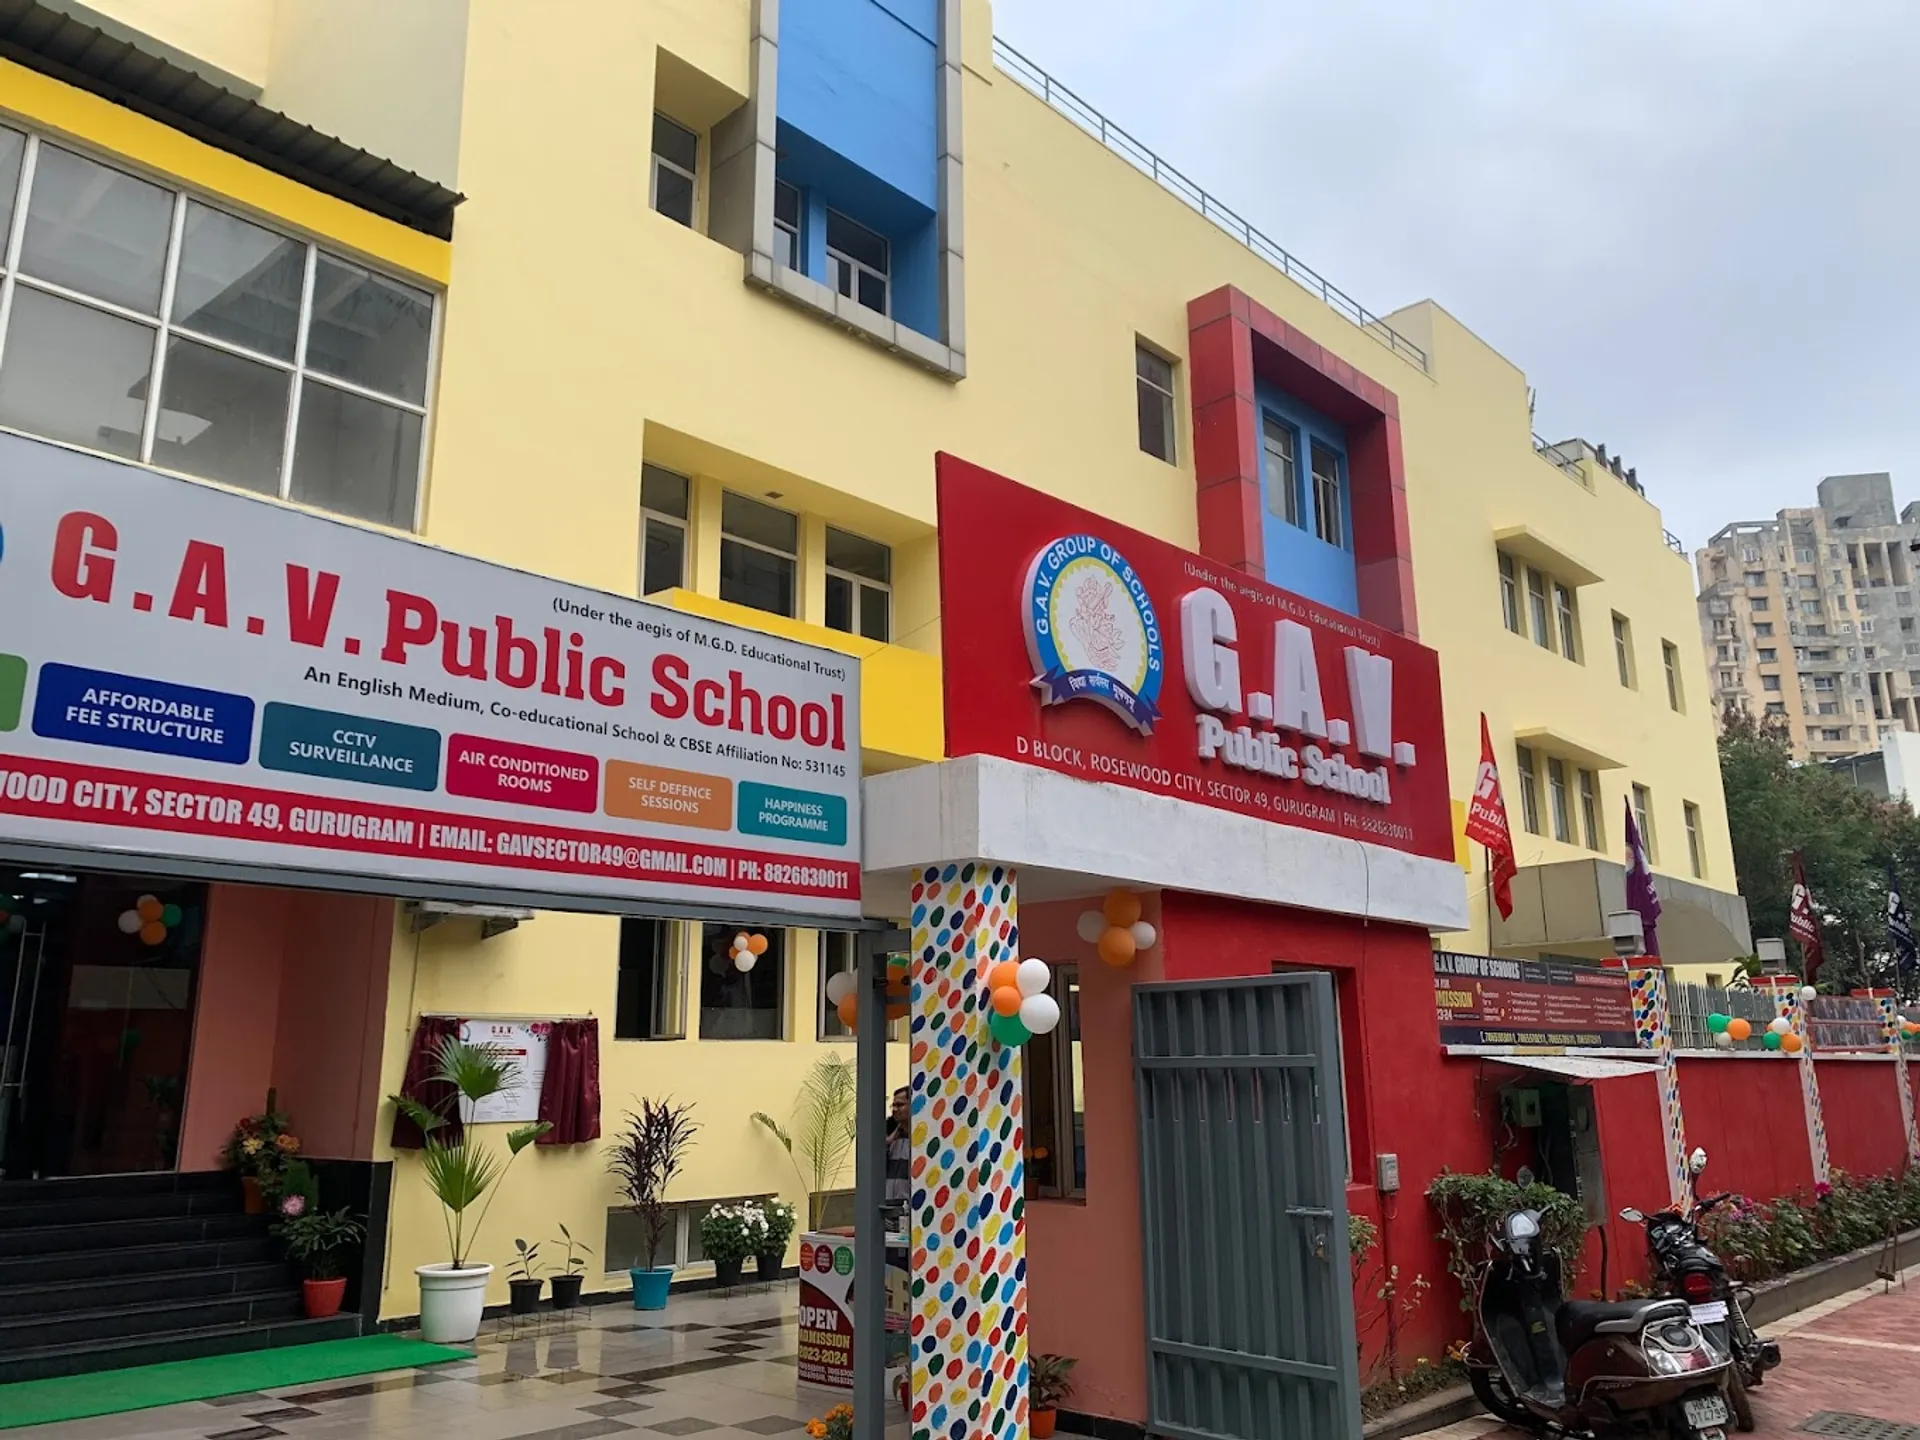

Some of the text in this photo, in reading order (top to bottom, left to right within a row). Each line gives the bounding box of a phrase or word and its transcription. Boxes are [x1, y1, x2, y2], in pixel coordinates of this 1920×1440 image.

[1036, 536, 1161, 673] G.A.V. GROUP OF SCHOOLS
[1183, 561, 1218, 586] (Under
[1220, 576, 1237, 593] the
[1239, 586, 1264, 604] aegis
[1266, 594, 1276, 608] of
[1309, 607, 1357, 638] Educational
[1358, 629, 1381, 649] Trust)
[50, 510, 846, 751] G.A.V. Public School
[552, 596, 846, 682] (Under the aegis of M.G.D. Educational Trust)
[1180, 587, 1416, 768] G.A.V.
[82, 688, 215, 723] AFFORDABLE
[303, 666, 846, 778] An English Medium, Co-educational School & CBSE Affiliation No: 531145
[66, 705, 225, 745] FEE STRUCTURE
[332, 729, 377, 749] CCTV
[289, 741, 414, 774] SURVEILLANCE
[458, 749, 590, 783] AIR CONDITIONED
[1196, 713, 1392, 805] Public School
[497, 773, 553, 794] ROOMS
[628, 777, 712, 801] SELF DEFENCE
[1016, 735, 1029, 755] D
[1033, 739, 1087, 771] BLOCK,
[1090, 753, 1172, 786] ROSEWOOD
[1174, 772, 1204, 796] CITY,
[1208, 780, 1252, 805] SECTOR
[1254, 790, 1271, 811] 49,
[1273, 795, 1336, 823] GURUGRAM
[1344, 811, 1360, 829] PH:
[640, 794, 700, 815] SESSIONS
[758, 811, 829, 832] PROGRAMME
[764, 797, 824, 817] HAPPINESS
[73, 780, 138, 816] CITY,
[144, 787, 243, 825] SECTOR
[247, 801, 284, 832] 49,
[288, 806, 414, 845] GURUGRAM
[429, 824, 493, 852] EMAIL:
[496, 831, 727, 878] GAVSECTOR49@GMAIL.COM
[738, 860, 762, 882] PH:
[764, 863, 849, 890] 8826830011
[1489, 960, 1520, 980] SCHOOLS
[799, 1305, 838, 1331] OPEN
